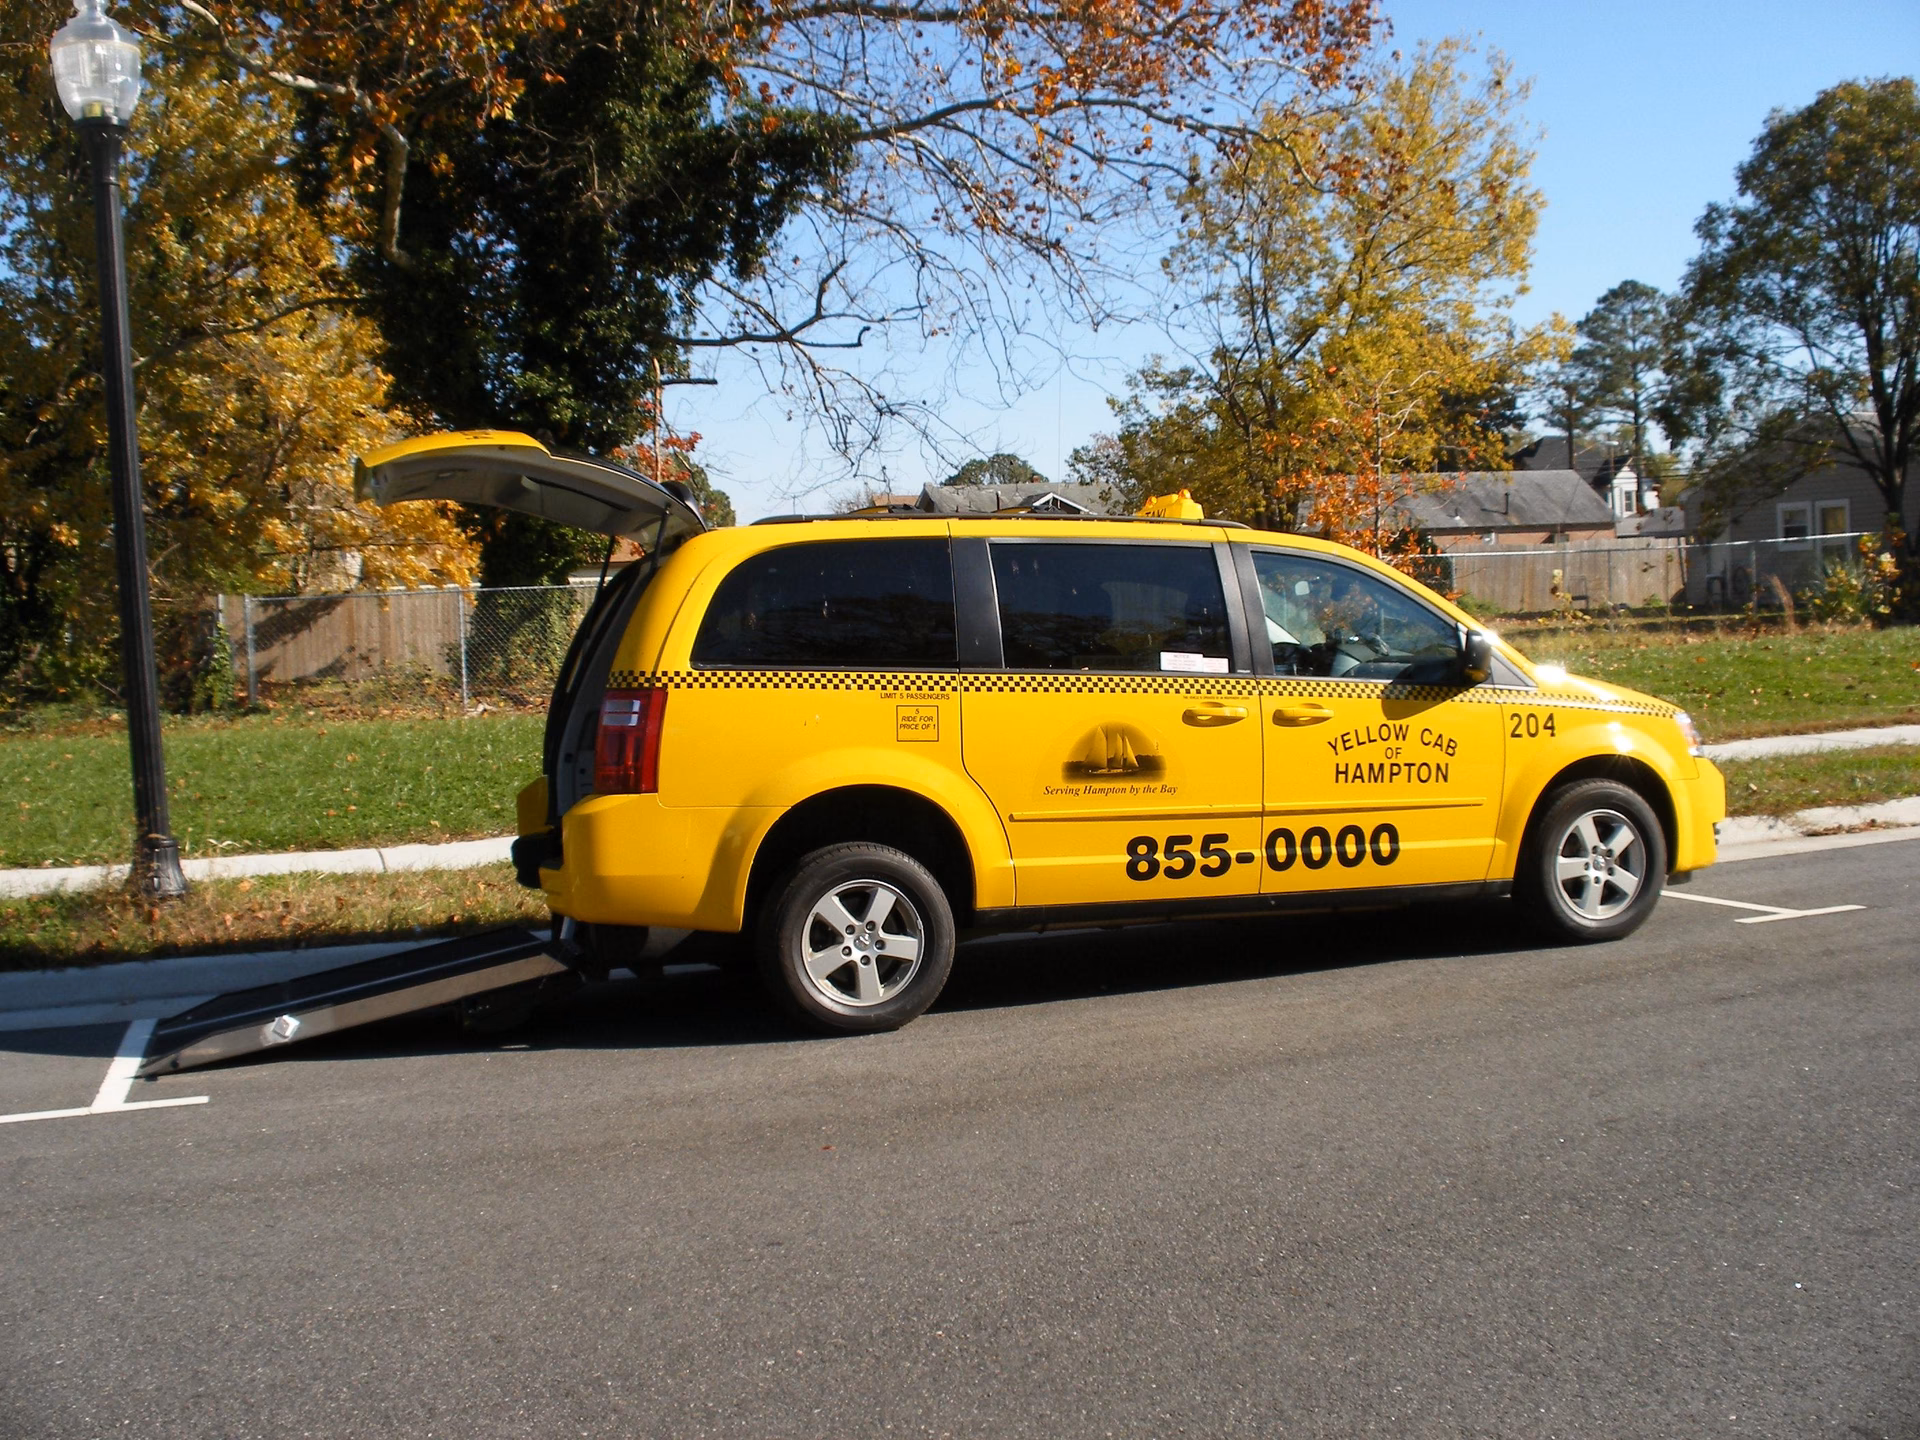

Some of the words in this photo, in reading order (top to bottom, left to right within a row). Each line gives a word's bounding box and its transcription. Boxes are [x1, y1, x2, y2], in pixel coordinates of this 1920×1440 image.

[1509, 712, 1557, 738] 204
[1327, 723, 1410, 756] YELLOW
[1420, 728, 1459, 757] CAB
[1384, 746, 1403, 760] OF
[1334, 762, 1450, 784] HAMPTON
[1043, 785, 1080, 796] Serving
[1083, 785, 1127, 796] Hampton
[1129, 784, 1141, 795] by
[1142, 784, 1158, 794] the
[1160, 784, 1178, 795] Bay
[1126, 823, 1400, 881] 855-0000
